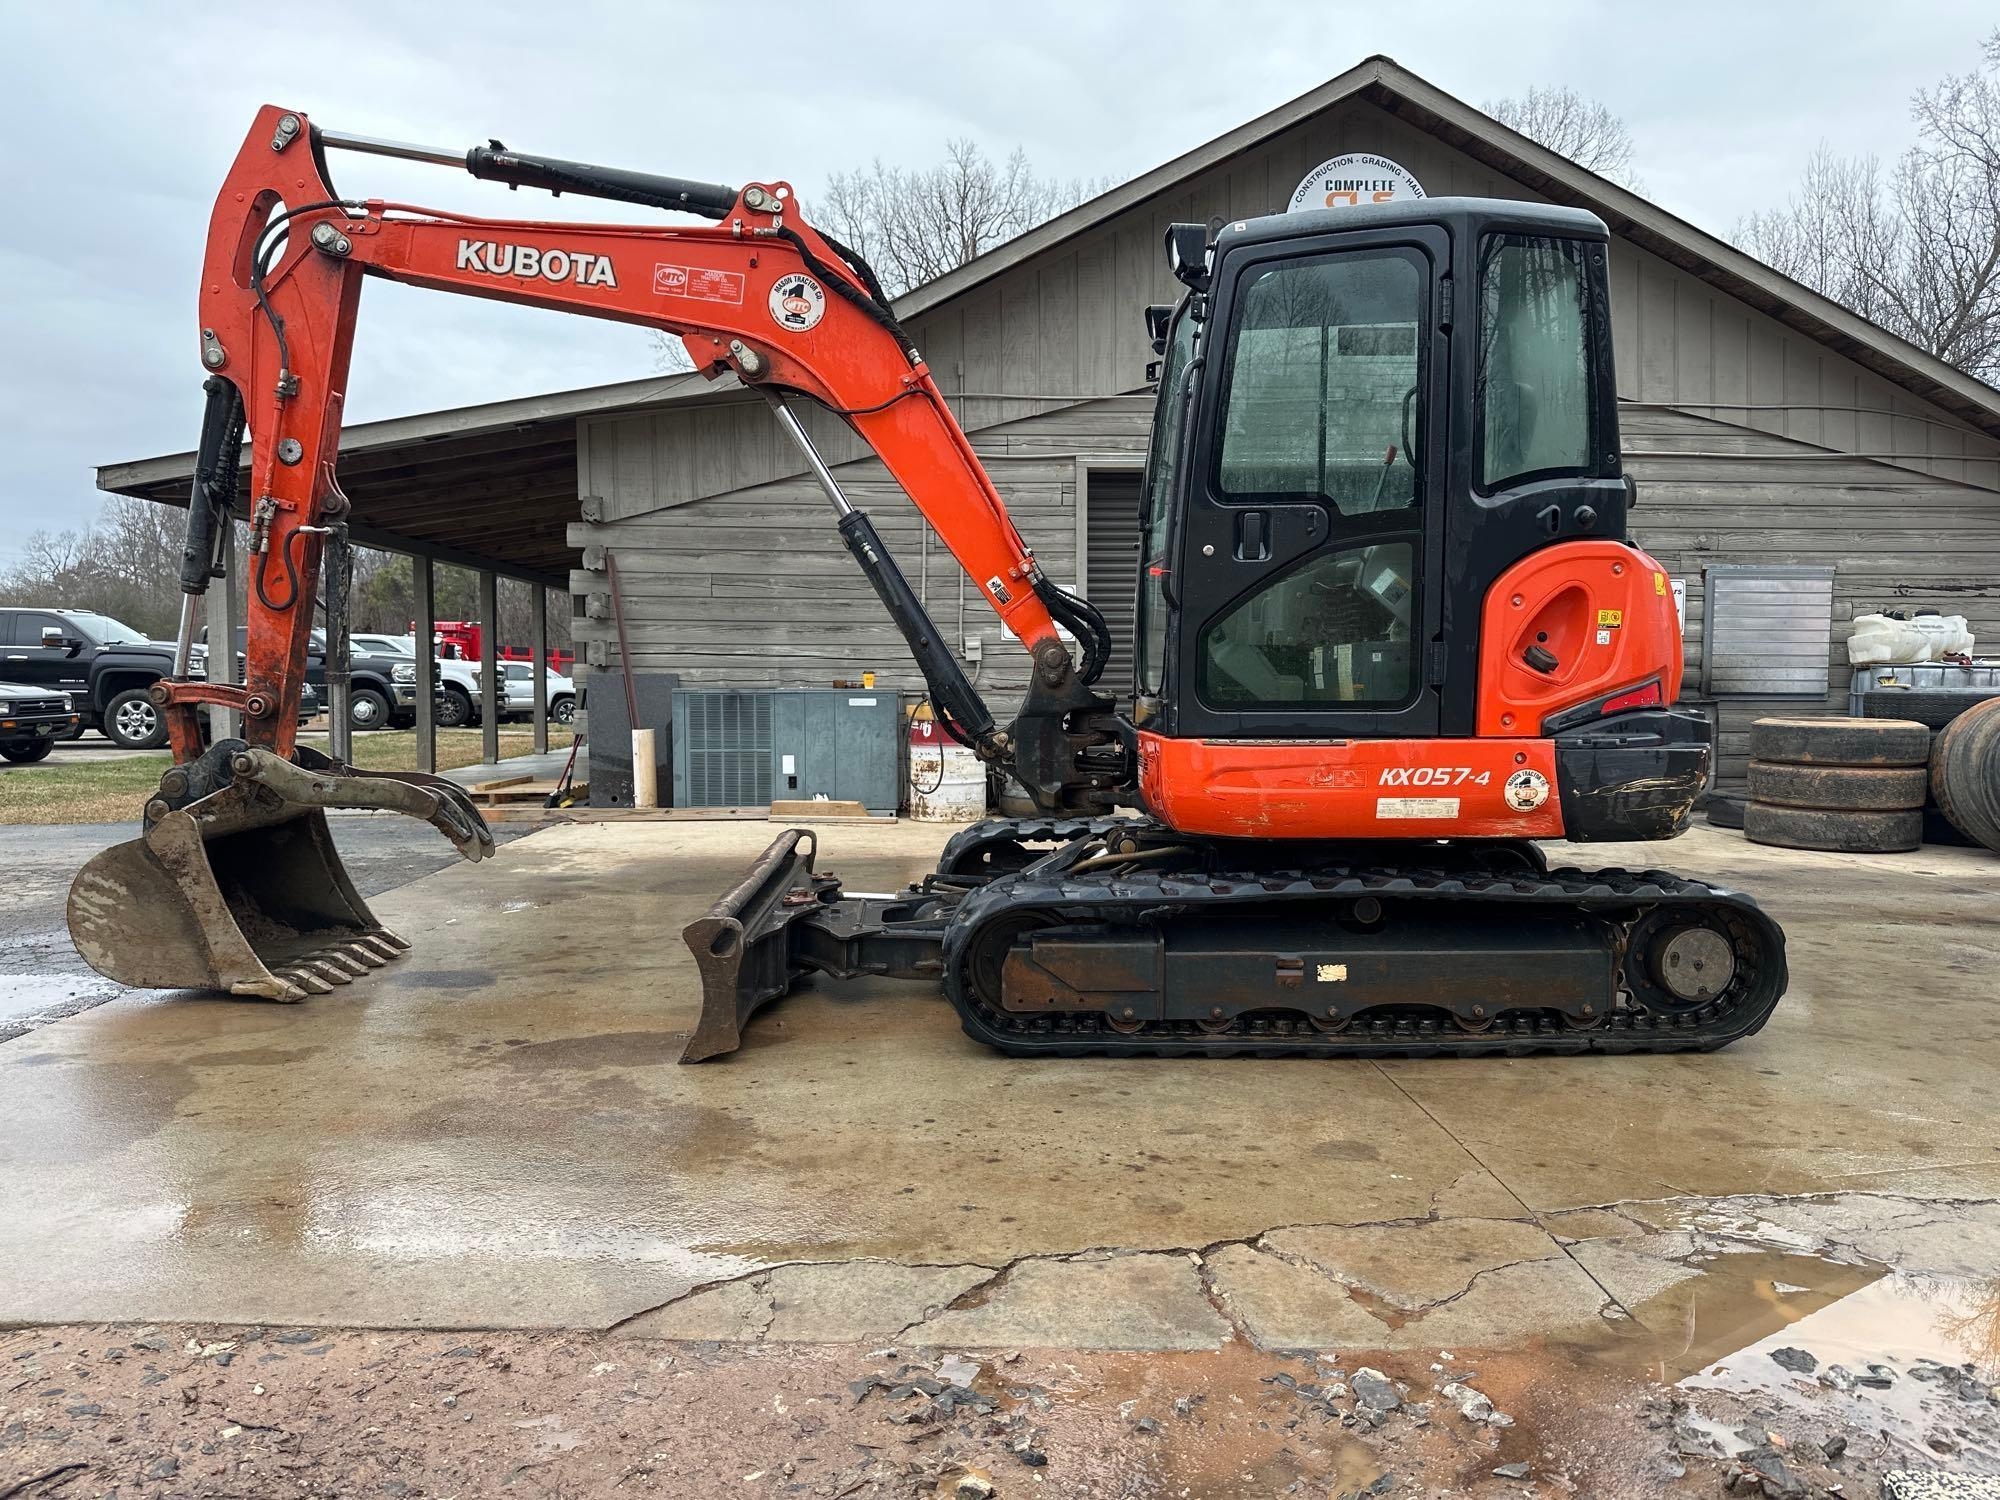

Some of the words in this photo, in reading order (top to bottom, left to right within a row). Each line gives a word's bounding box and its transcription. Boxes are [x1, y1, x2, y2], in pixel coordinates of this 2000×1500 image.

[1295, 156, 1354, 203] CONSTRUCTION
[1361, 156, 1402, 177] GRADING
[1325, 179, 1396, 191] COMPLETE
[455, 238, 619, 288] KUBOTA
[774, 276, 793, 294] MASON
[793, 275, 819, 292] TRACTOR
[1378, 767, 1492, 786] KX057-4
[1507, 774, 1522, 787] MASON
[1521, 771, 1542, 781] TRACTOR
